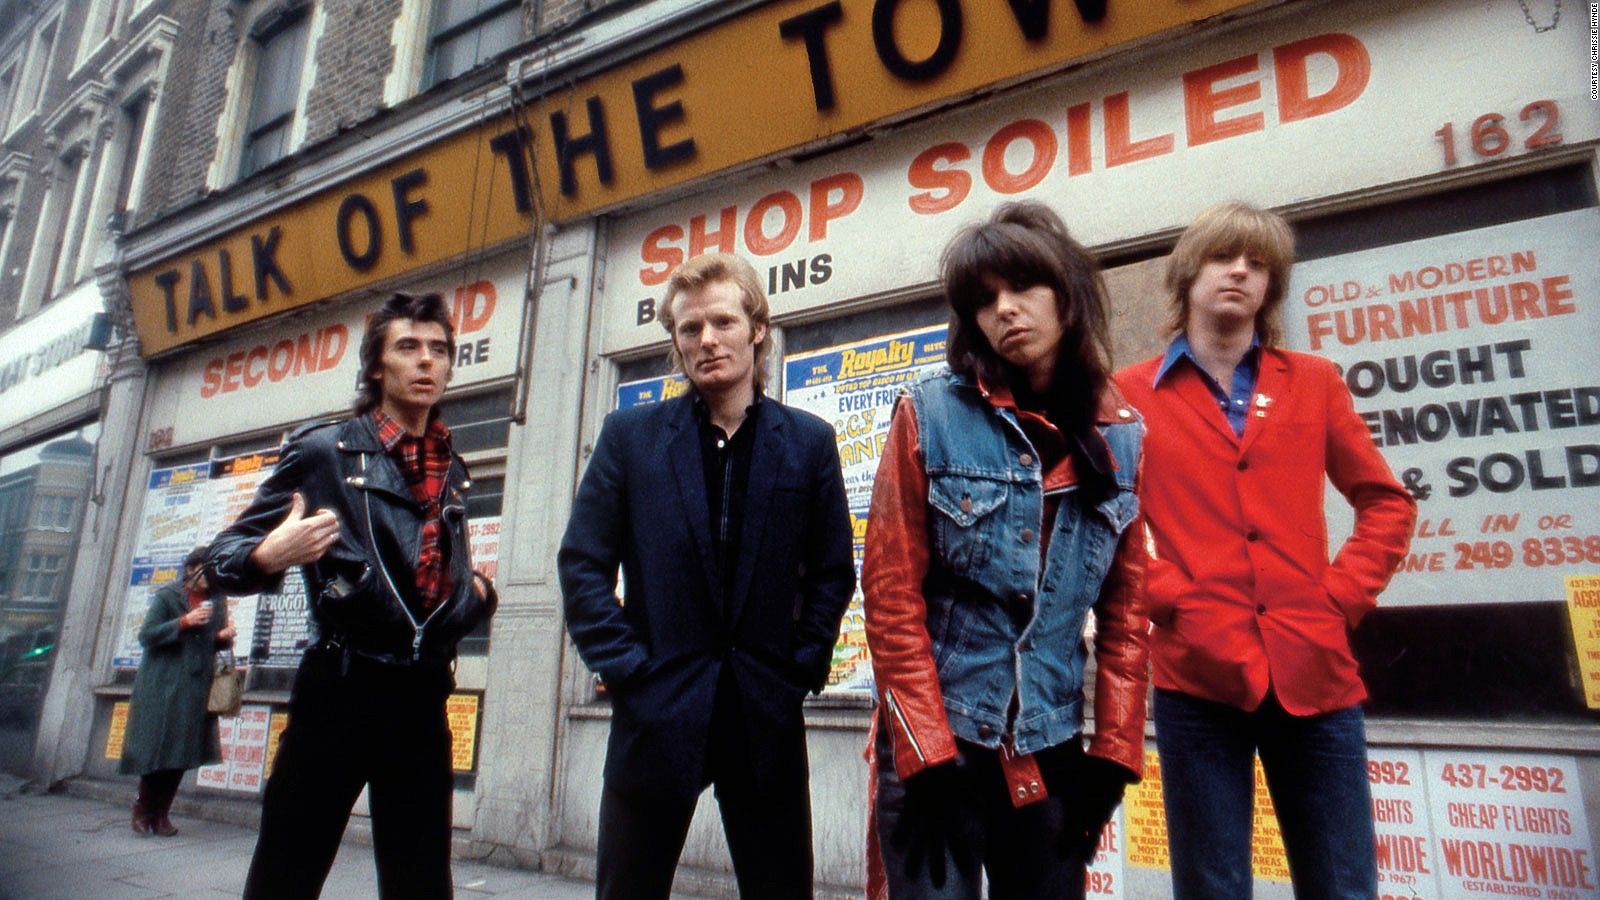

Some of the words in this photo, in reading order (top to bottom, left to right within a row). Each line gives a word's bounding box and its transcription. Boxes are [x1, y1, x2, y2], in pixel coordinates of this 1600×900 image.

[639, 171, 864, 286] SHOP
[908, 32, 1372, 216] SOILED
[1434, 100, 1563, 167] 162
[155, 226, 293, 334] TALK
[336, 168, 429, 273] OF
[490, 63, 698, 217] THE
[778, 0, 1112, 113] TO
[1303, 281, 1361, 308] OLD
[1388, 250, 1537, 293] MODERN
[1307, 274, 1576, 351] FURNITURE
[201, 324, 348, 399] SECOND
[837, 340, 915, 380] Royalty
[1335, 339, 1531, 398] OUGHT
[838, 394, 873, 413] EVERY
[1359, 386, 1600, 448] ENOVATED
[1401, 467, 1432, 500] &
[1446, 444, 1600, 498] SOLD
[1480, 513, 1520, 534] IN
[1537, 514, 1573, 530] OR
[1454, 540, 1514, 570] 249
[1521, 535, 1600, 568] 8338
[1441, 763, 1567, 793] 437-2992
[1447, 801, 1498, 831] CHEAP
[1503, 805, 1572, 836] FLIGHTS
[1137, 845, 1159, 856] MOST
[1253, 856, 1282, 867] AREAS
[1441, 838, 1595, 891] WORLDWIDE
[1463, 880, 1541, 898] (ESTABLISHED
